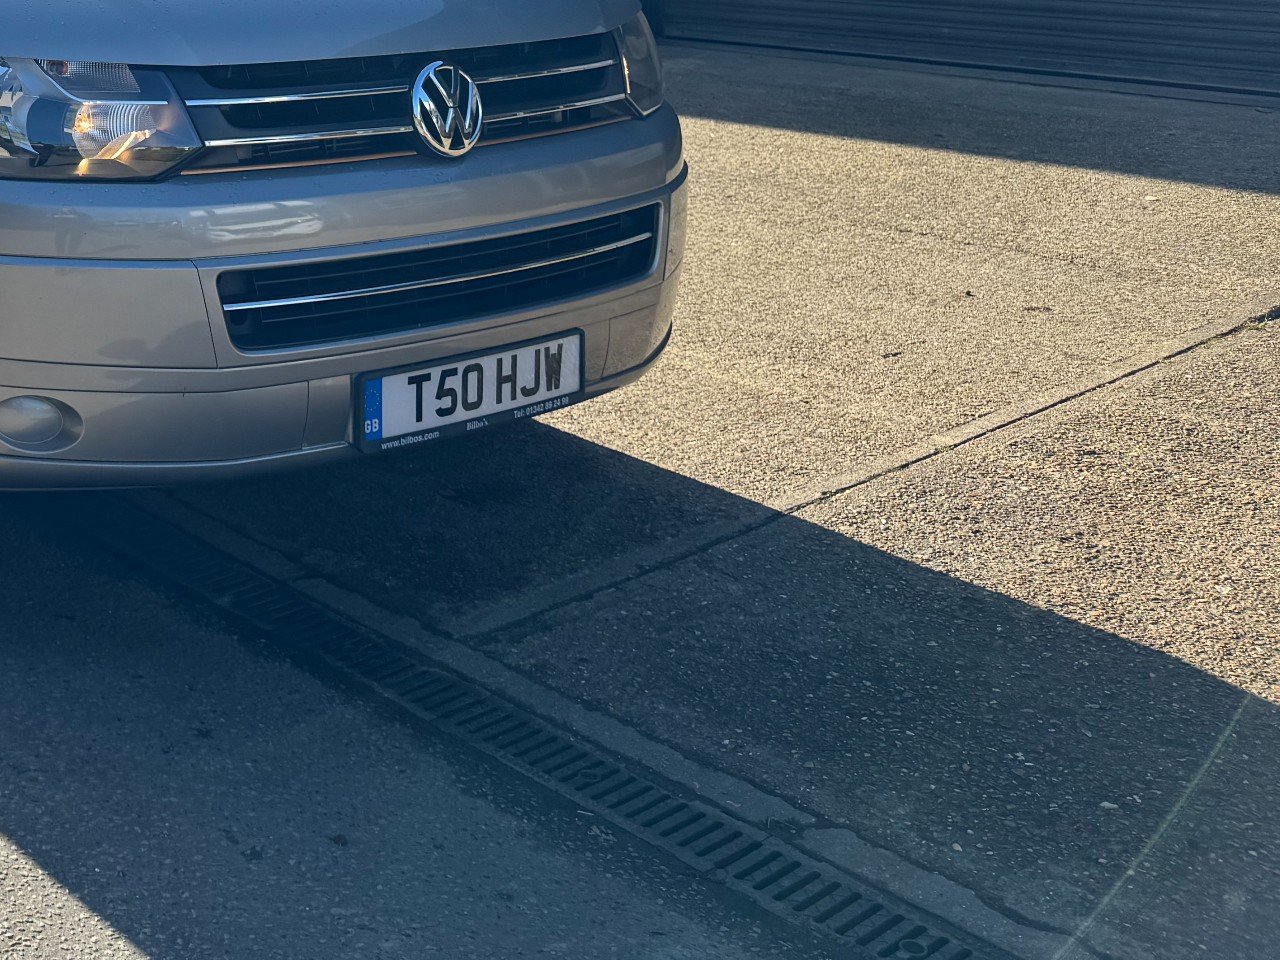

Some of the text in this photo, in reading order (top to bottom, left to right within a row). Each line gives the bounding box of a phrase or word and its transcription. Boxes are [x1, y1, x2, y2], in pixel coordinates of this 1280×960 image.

[407, 343, 564, 423] T50 HJW
[513, 408, 525, 418] Tel:
[526, 403, 544, 415] 01342
[364, 418, 379, 434] GB
[381, 431, 440, 450] www.bilbos.com
